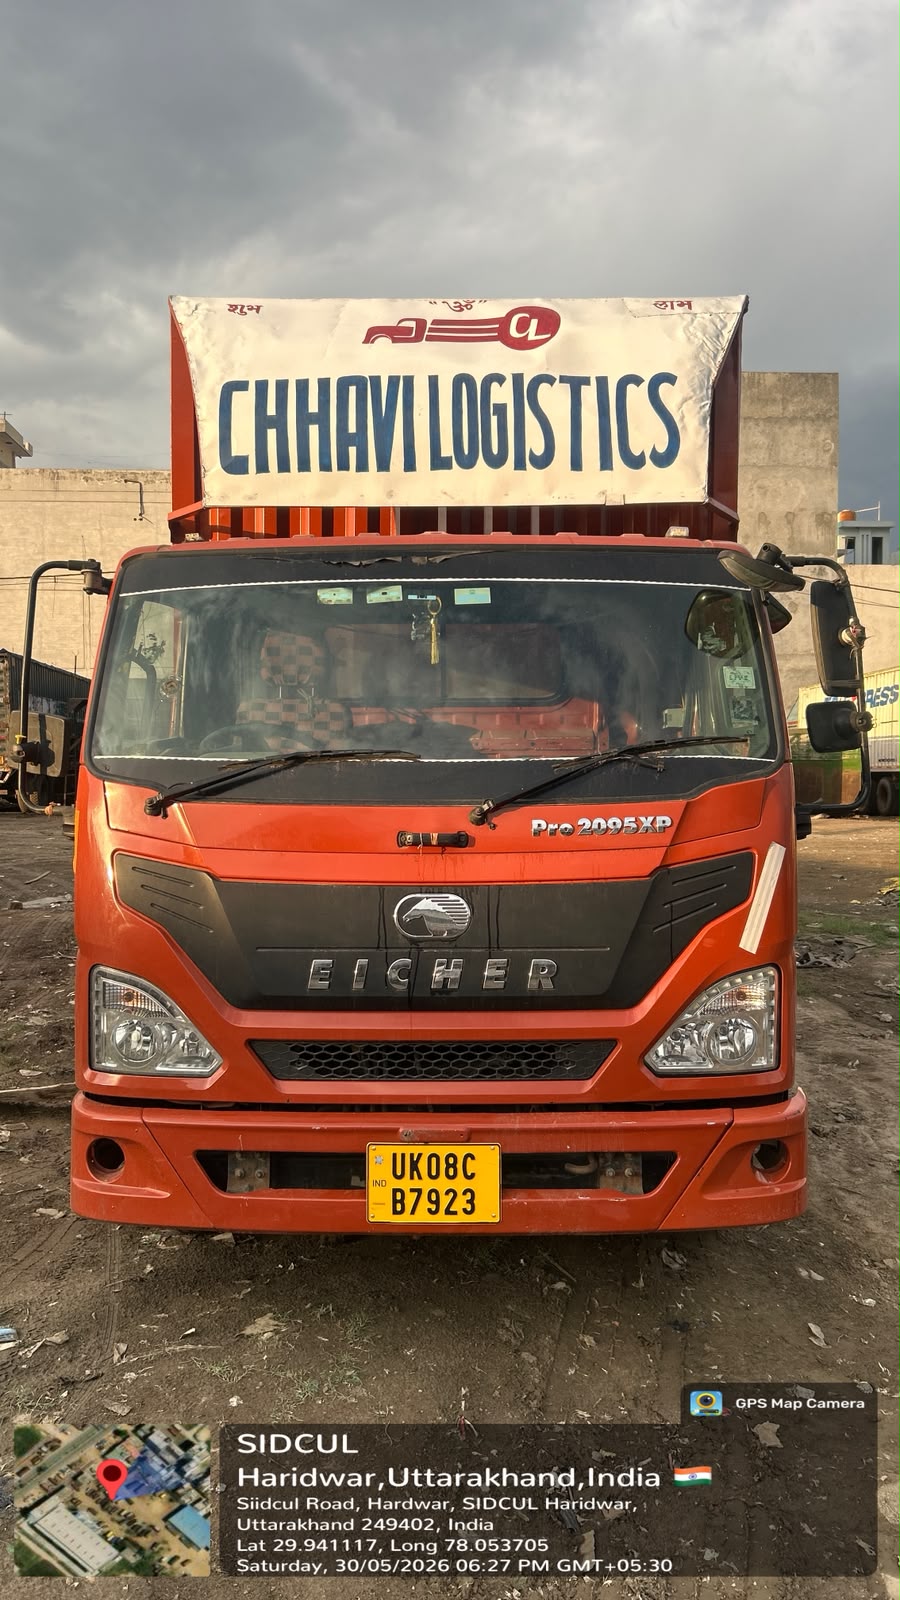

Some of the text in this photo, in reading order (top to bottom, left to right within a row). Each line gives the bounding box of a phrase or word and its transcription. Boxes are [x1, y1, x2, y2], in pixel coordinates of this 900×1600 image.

[226, 303, 264, 316] शुभ
[653, 300, 693, 311] लाभ
[219, 371, 681, 475] CHHAVI LOGISTICS
[531, 815, 673, 837] Pro 2095XP
[307, 958, 558, 990] EICHER
[392, 1152, 476, 1180] UK08C
[372, 1179, 387, 1188] IND
[392, 1187, 476, 1215] B7923
